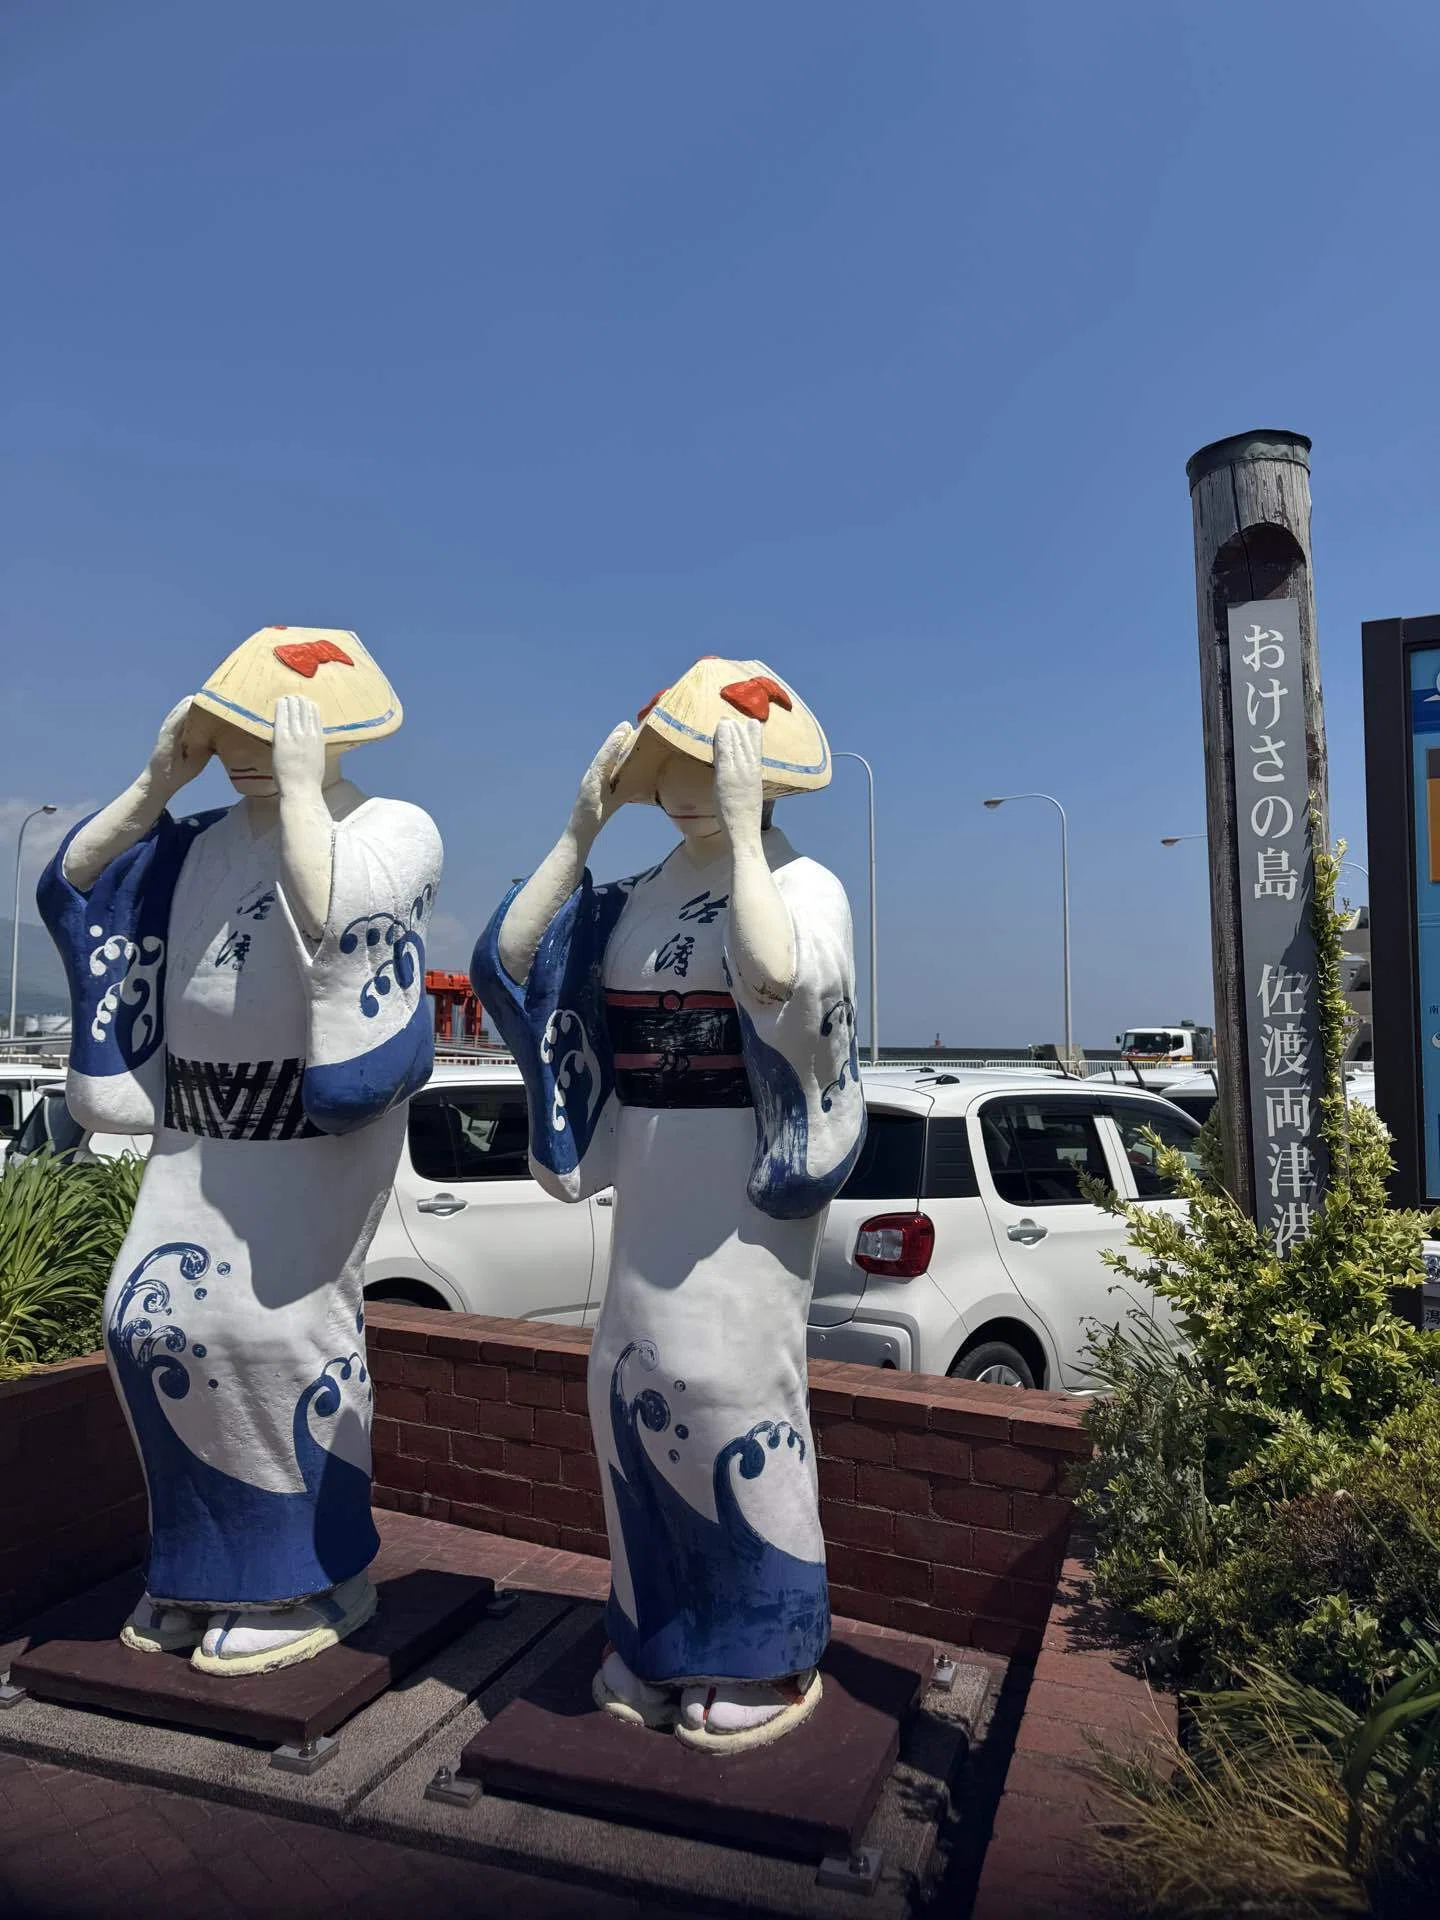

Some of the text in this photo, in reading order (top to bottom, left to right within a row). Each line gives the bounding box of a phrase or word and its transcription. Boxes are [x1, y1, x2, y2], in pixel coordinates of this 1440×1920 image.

[654, 890, 729, 977] 佐渡
[1242, 624, 1315, 1258] おけさの島 佐渡両津港
